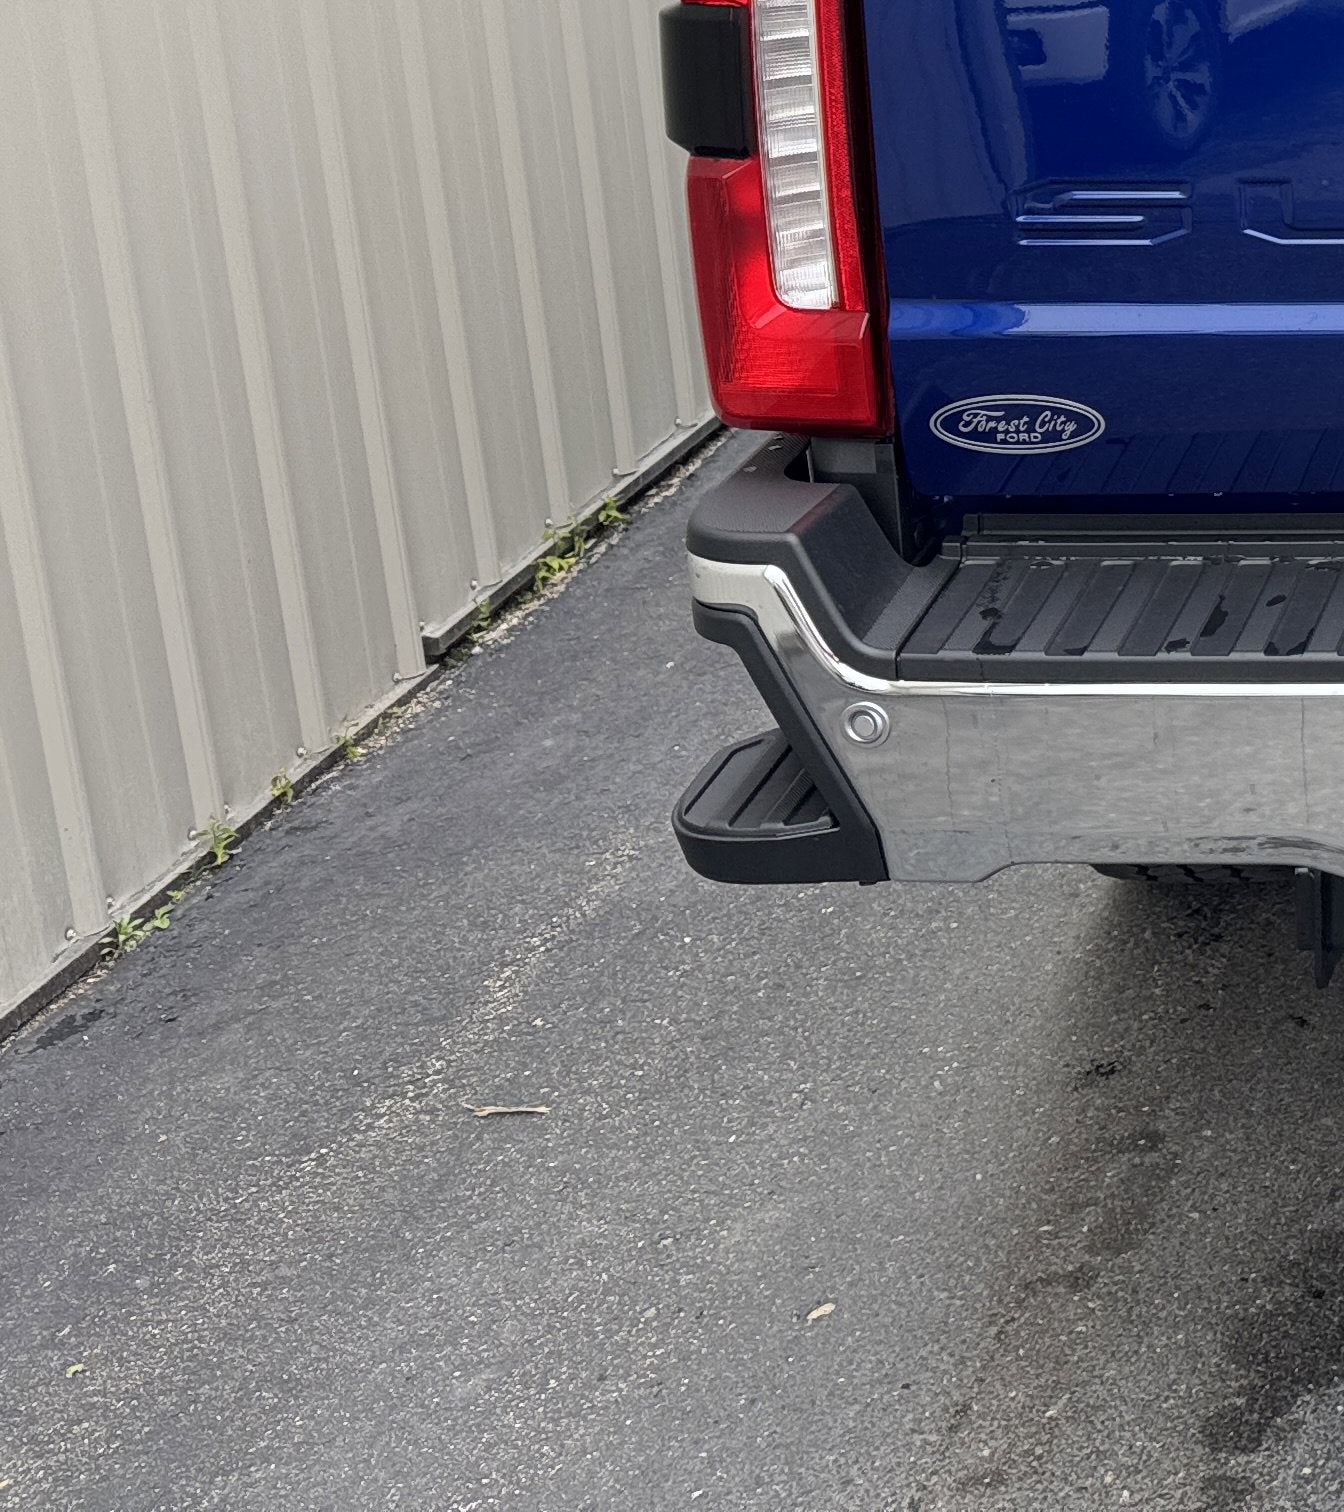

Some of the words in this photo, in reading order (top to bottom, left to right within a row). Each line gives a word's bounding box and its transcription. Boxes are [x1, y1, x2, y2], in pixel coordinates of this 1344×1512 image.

[958, 409, 1031, 433] Forest
[1035, 410, 1077, 440] City
[996, 433, 1042, 442] FORD
